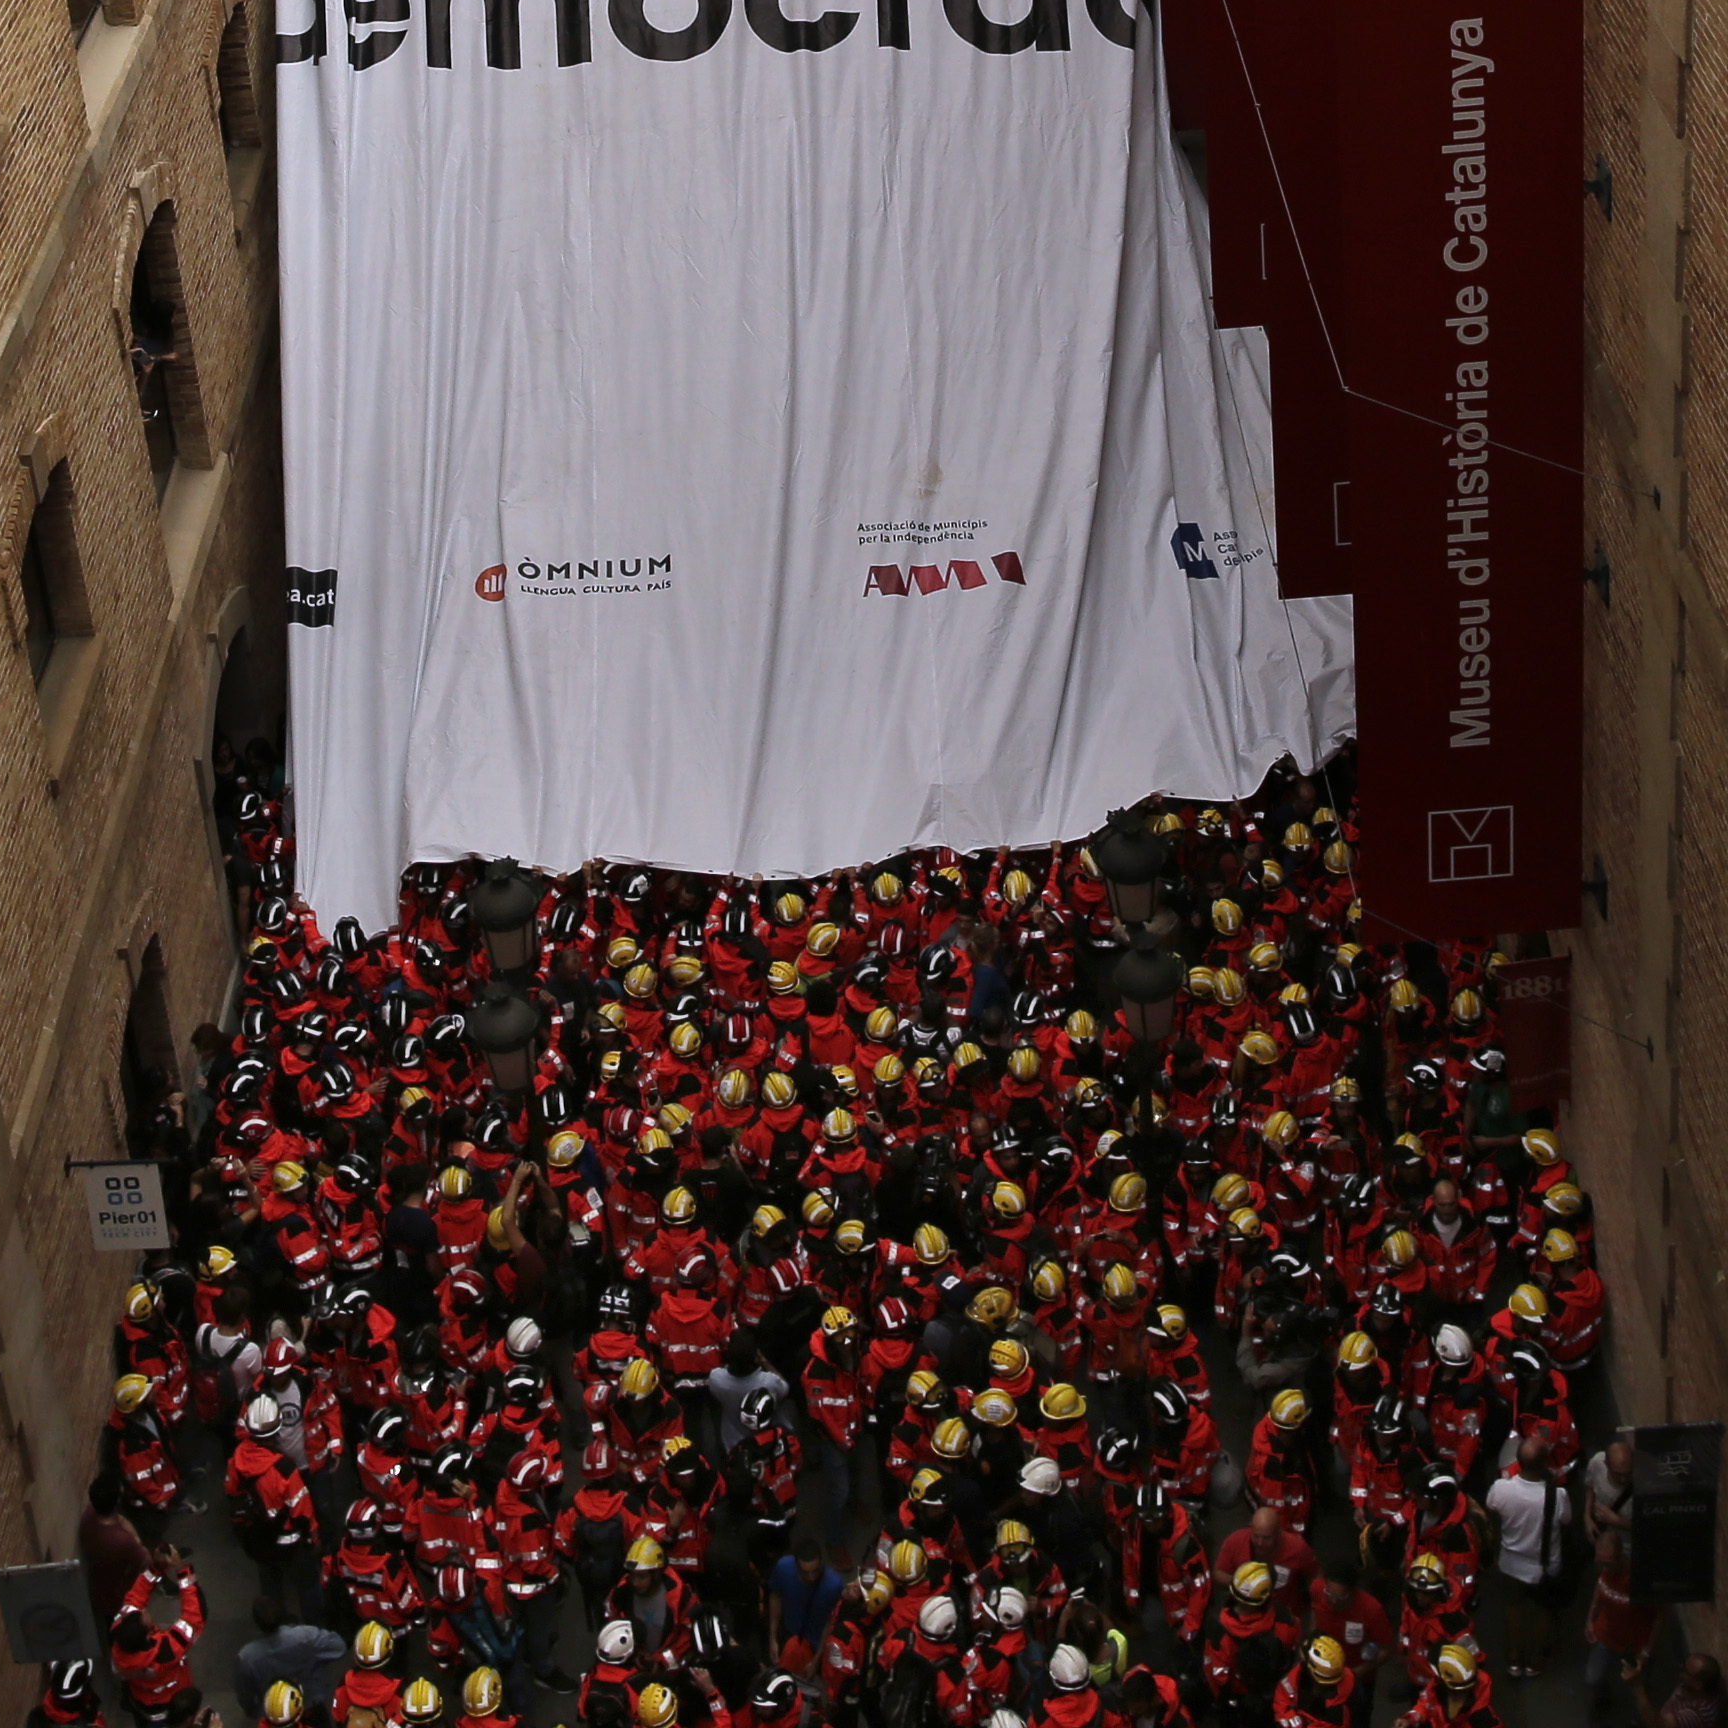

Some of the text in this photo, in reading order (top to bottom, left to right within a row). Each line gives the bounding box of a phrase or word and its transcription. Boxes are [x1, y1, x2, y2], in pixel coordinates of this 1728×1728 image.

[1441, 17, 1495, 748] Museu d'Història de Catalunya
[857, 519, 988, 533] Associació de Municipis
[858, 530, 975, 546] per la Independència
[517, 553, 672, 581] ÒMNIUM
[520, 579, 672, 596] LLENGUA CULTURA PAÍS
[286, 587, 335, 607] a.cat
[99, 1210, 157, 1225] Pier01
